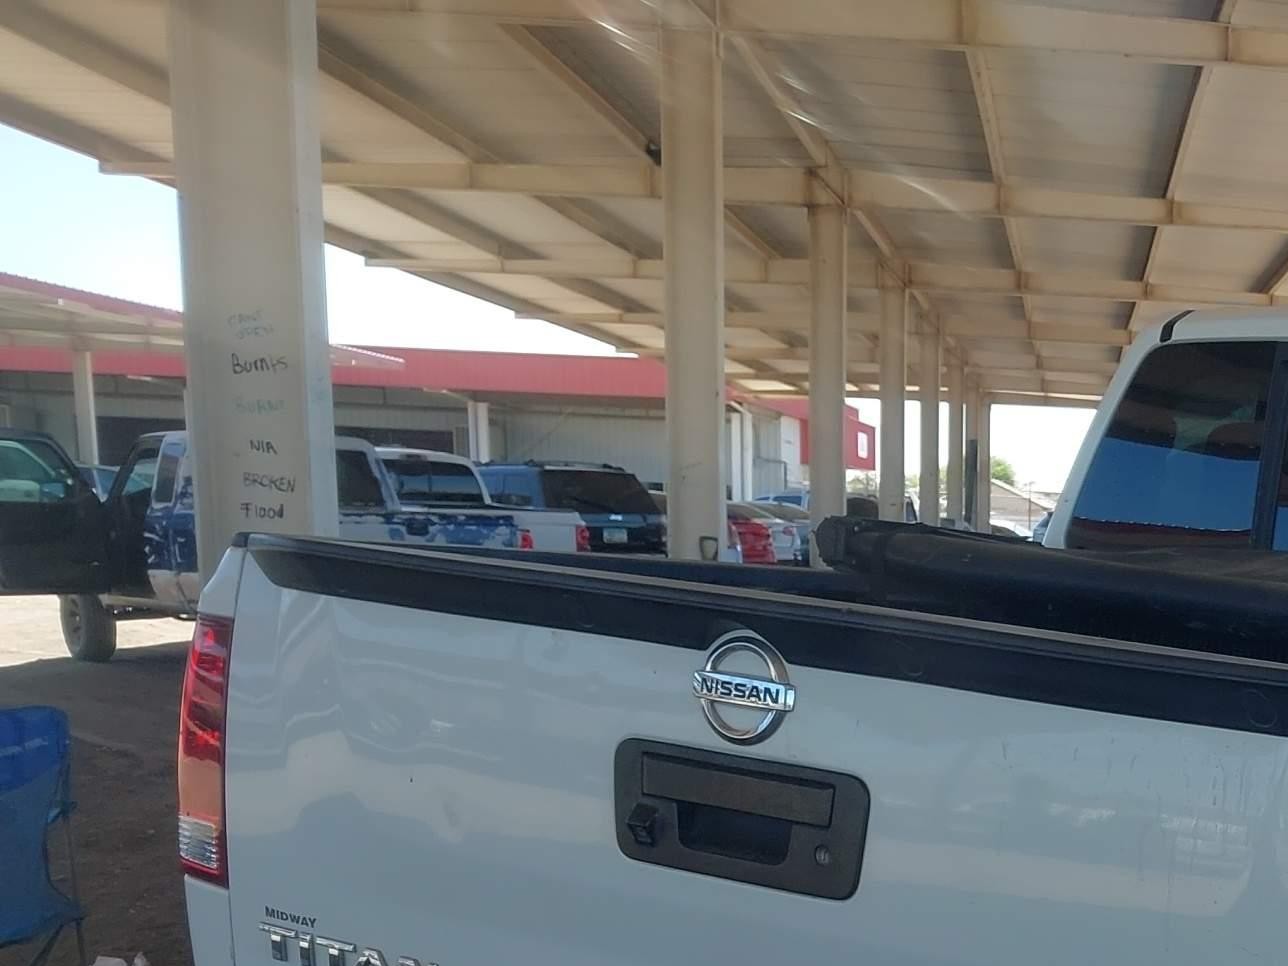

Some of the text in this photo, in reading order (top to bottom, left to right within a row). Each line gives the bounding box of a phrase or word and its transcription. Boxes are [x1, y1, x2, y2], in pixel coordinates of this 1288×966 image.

[243, 471, 296, 493] BROKEN
[700, 677, 780, 705] NISSAN
[265, 906, 317, 928] MIDWAY
